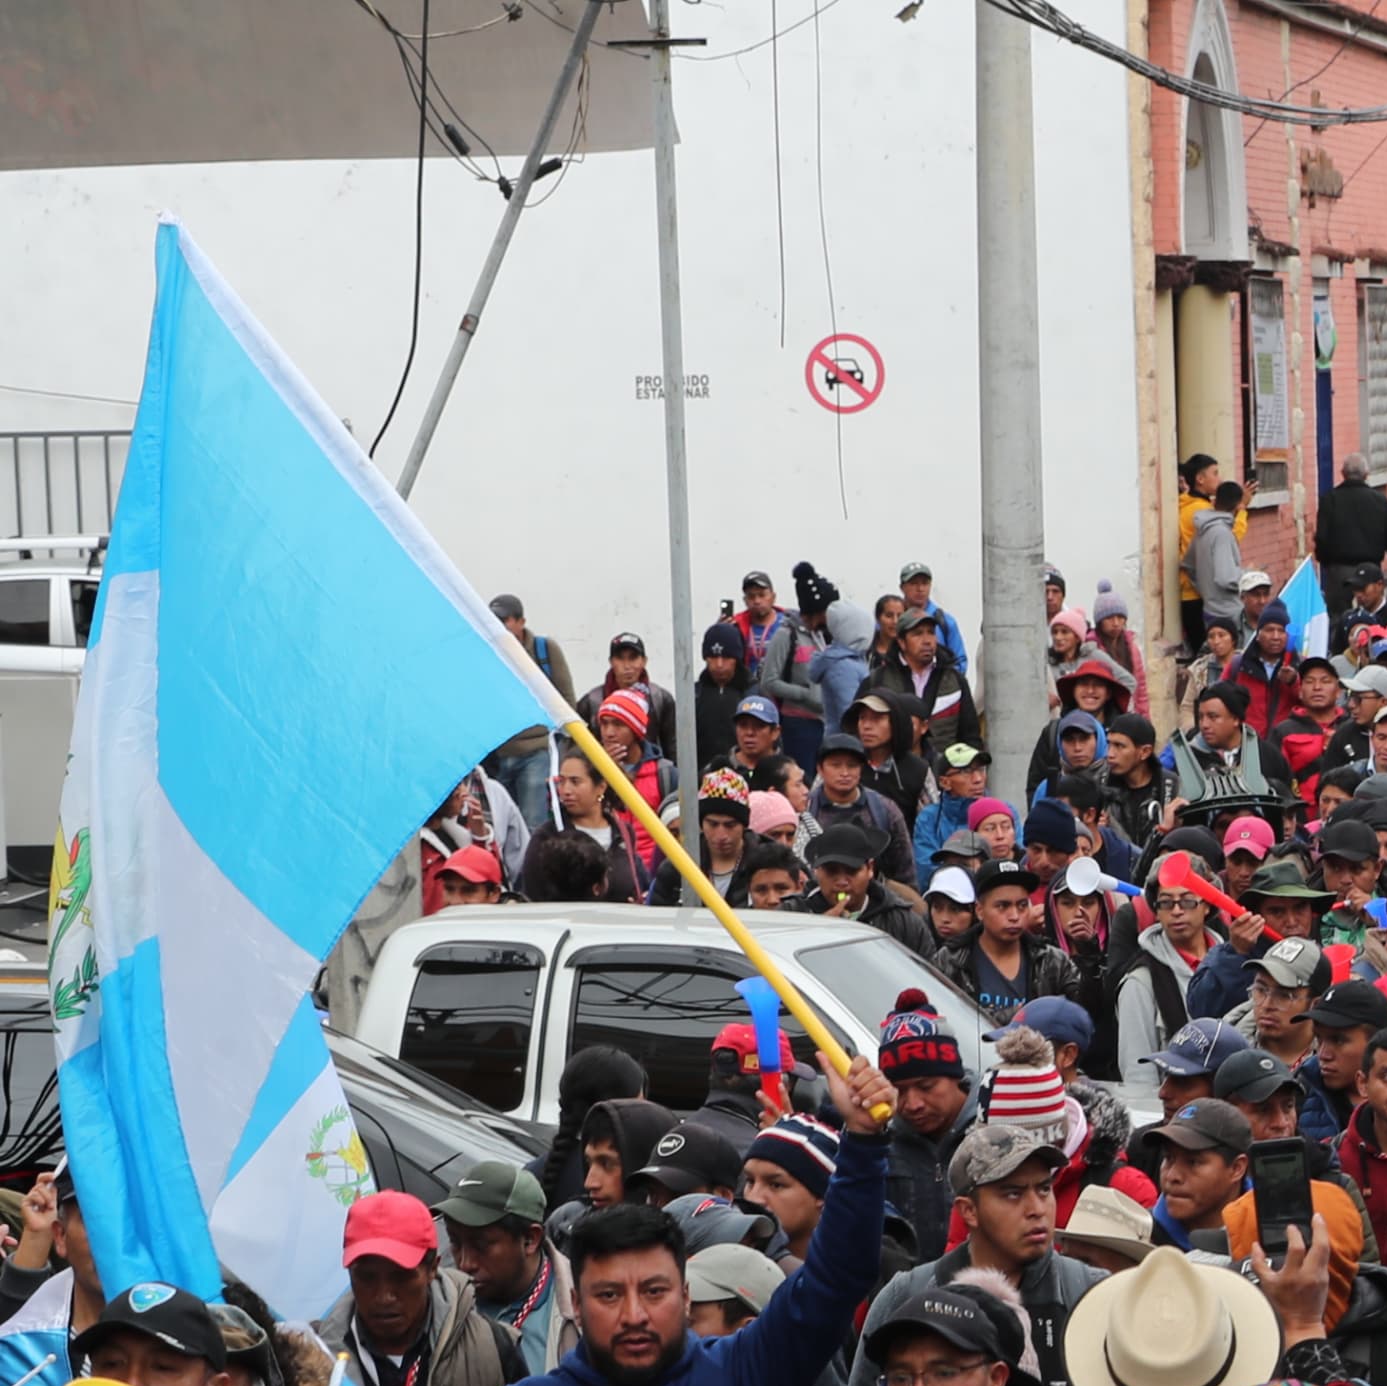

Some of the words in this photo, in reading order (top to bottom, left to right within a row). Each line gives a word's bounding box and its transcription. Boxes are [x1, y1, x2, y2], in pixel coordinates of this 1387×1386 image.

[635, 374, 709, 389] PROIDO
[635, 386, 710, 400] ESTANAR
[880, 1040, 957, 1069] ARIS
